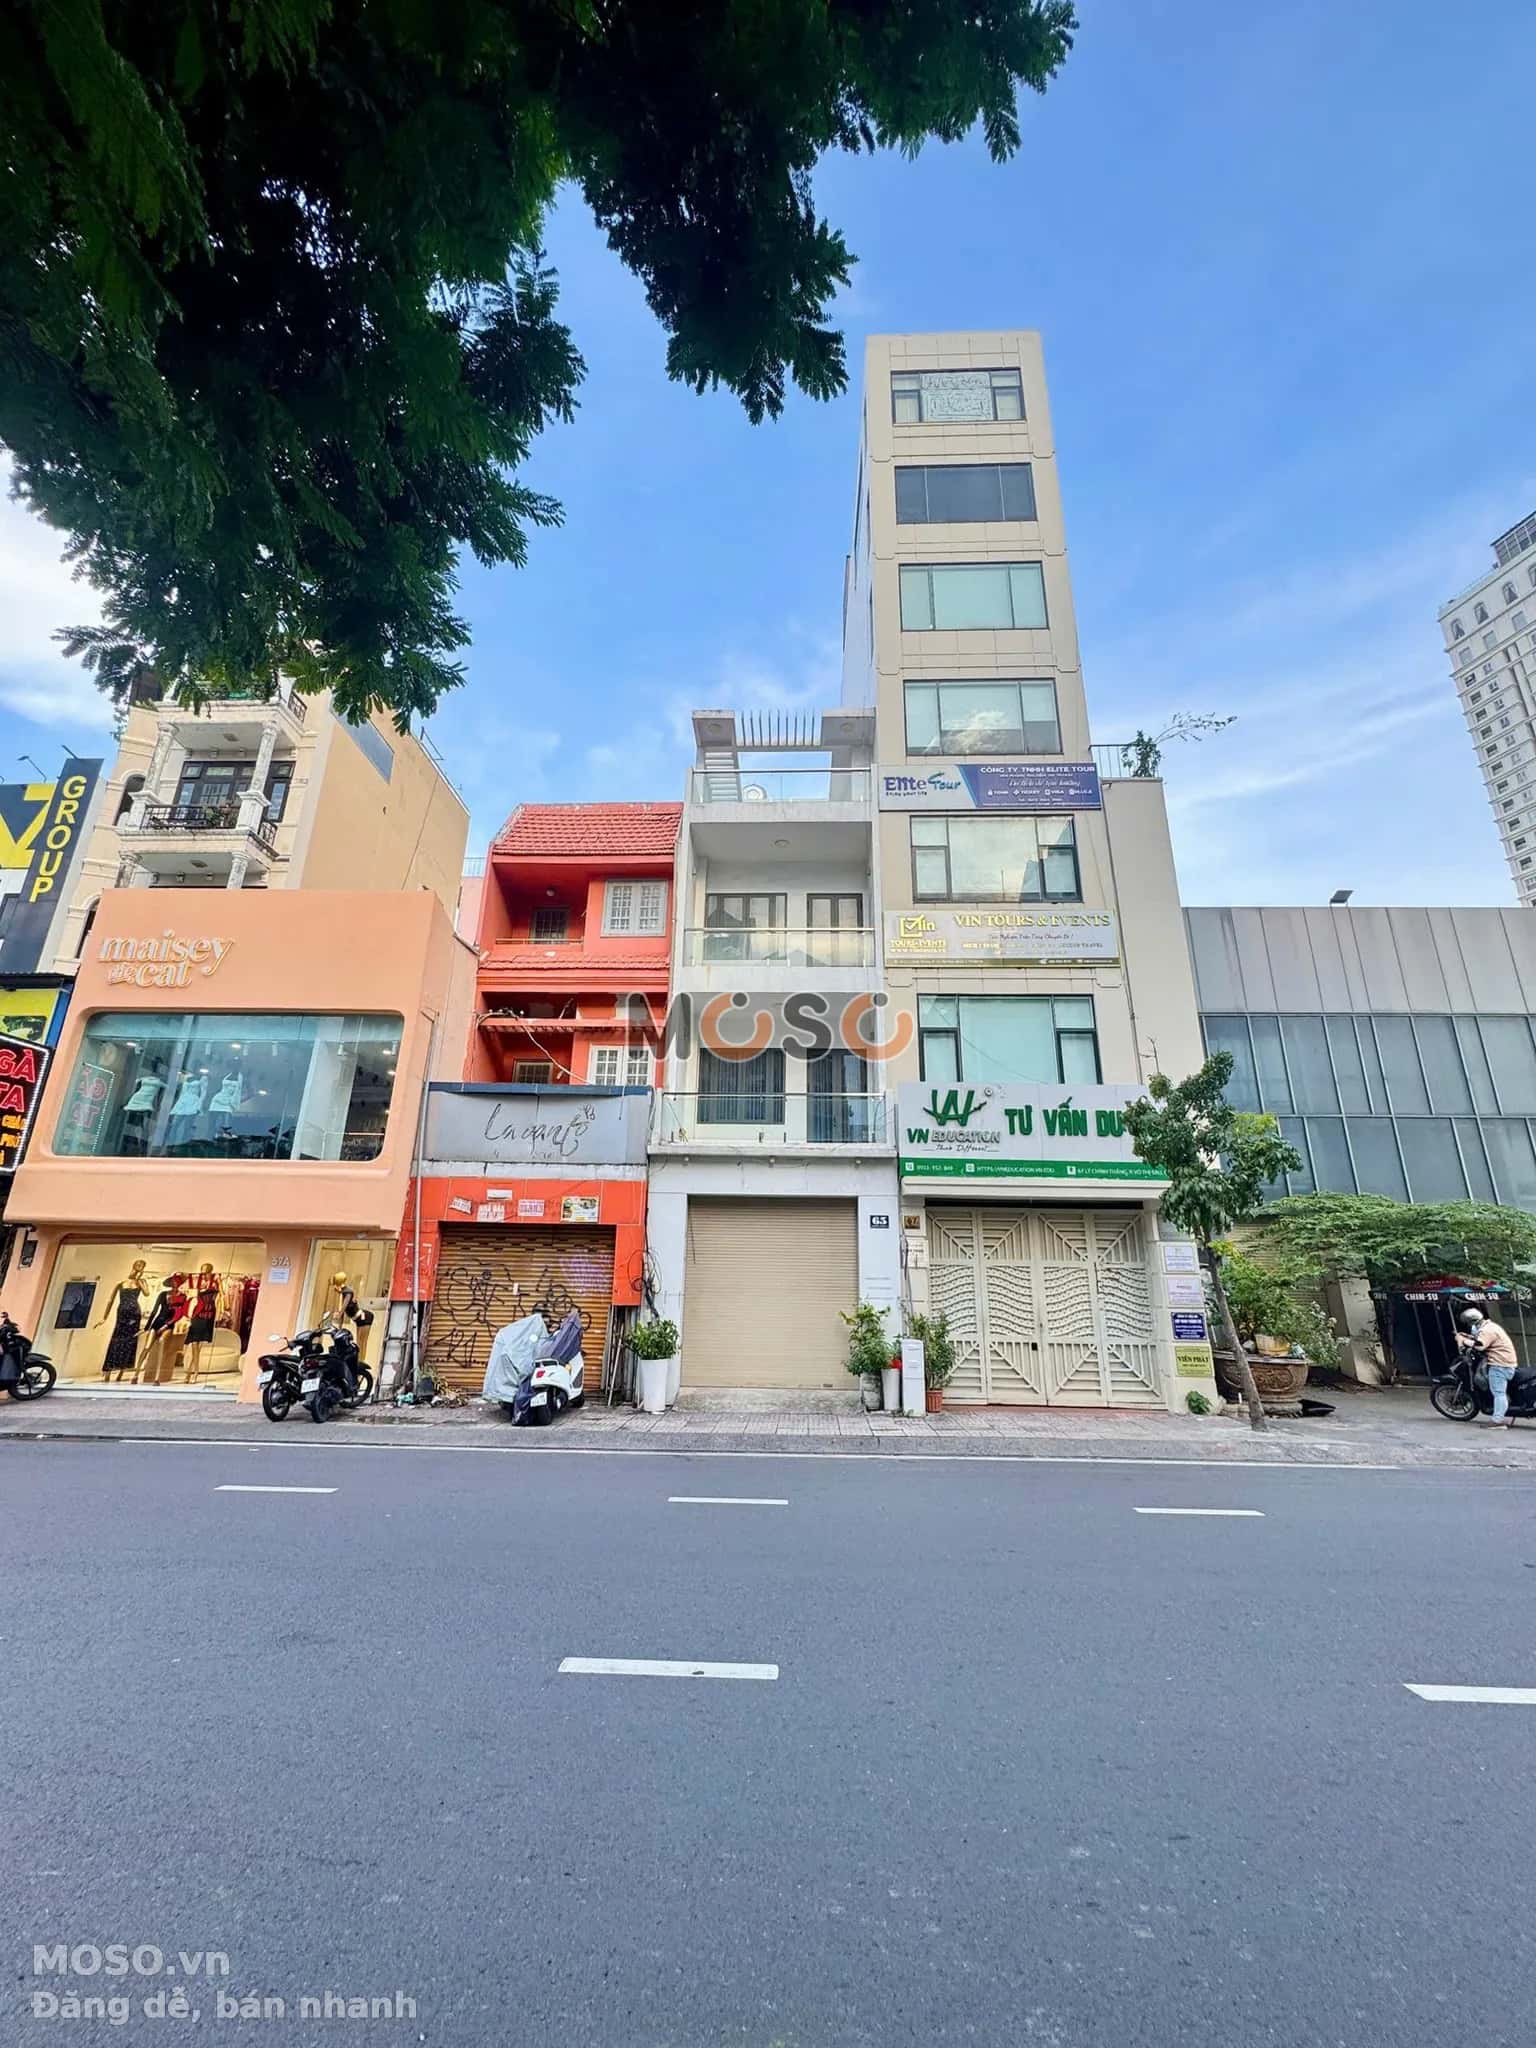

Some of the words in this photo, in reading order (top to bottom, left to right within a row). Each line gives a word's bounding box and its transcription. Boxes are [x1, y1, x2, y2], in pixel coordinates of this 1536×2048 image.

[29, 775, 87, 903] GROUP
[954, 915, 982, 928] VIN
[985, 915, 1034, 928] TOURS
[1036, 915, 1048, 927] &
[1051, 915, 1111, 927] EVENTS
[97, 929, 236, 977] maisey
[135, 962, 193, 988] cat
[1004, 1104, 1032, 1135] TƯ
[1042, 1096, 1088, 1137] VẤN
[907, 1128, 929, 1144] VN
[931, 1129, 1001, 1144] EDUCATION
[1404, 1292, 1439, 1301] CHIN-SU
[1464, 1292, 1500, 1301] CHIN-SU
